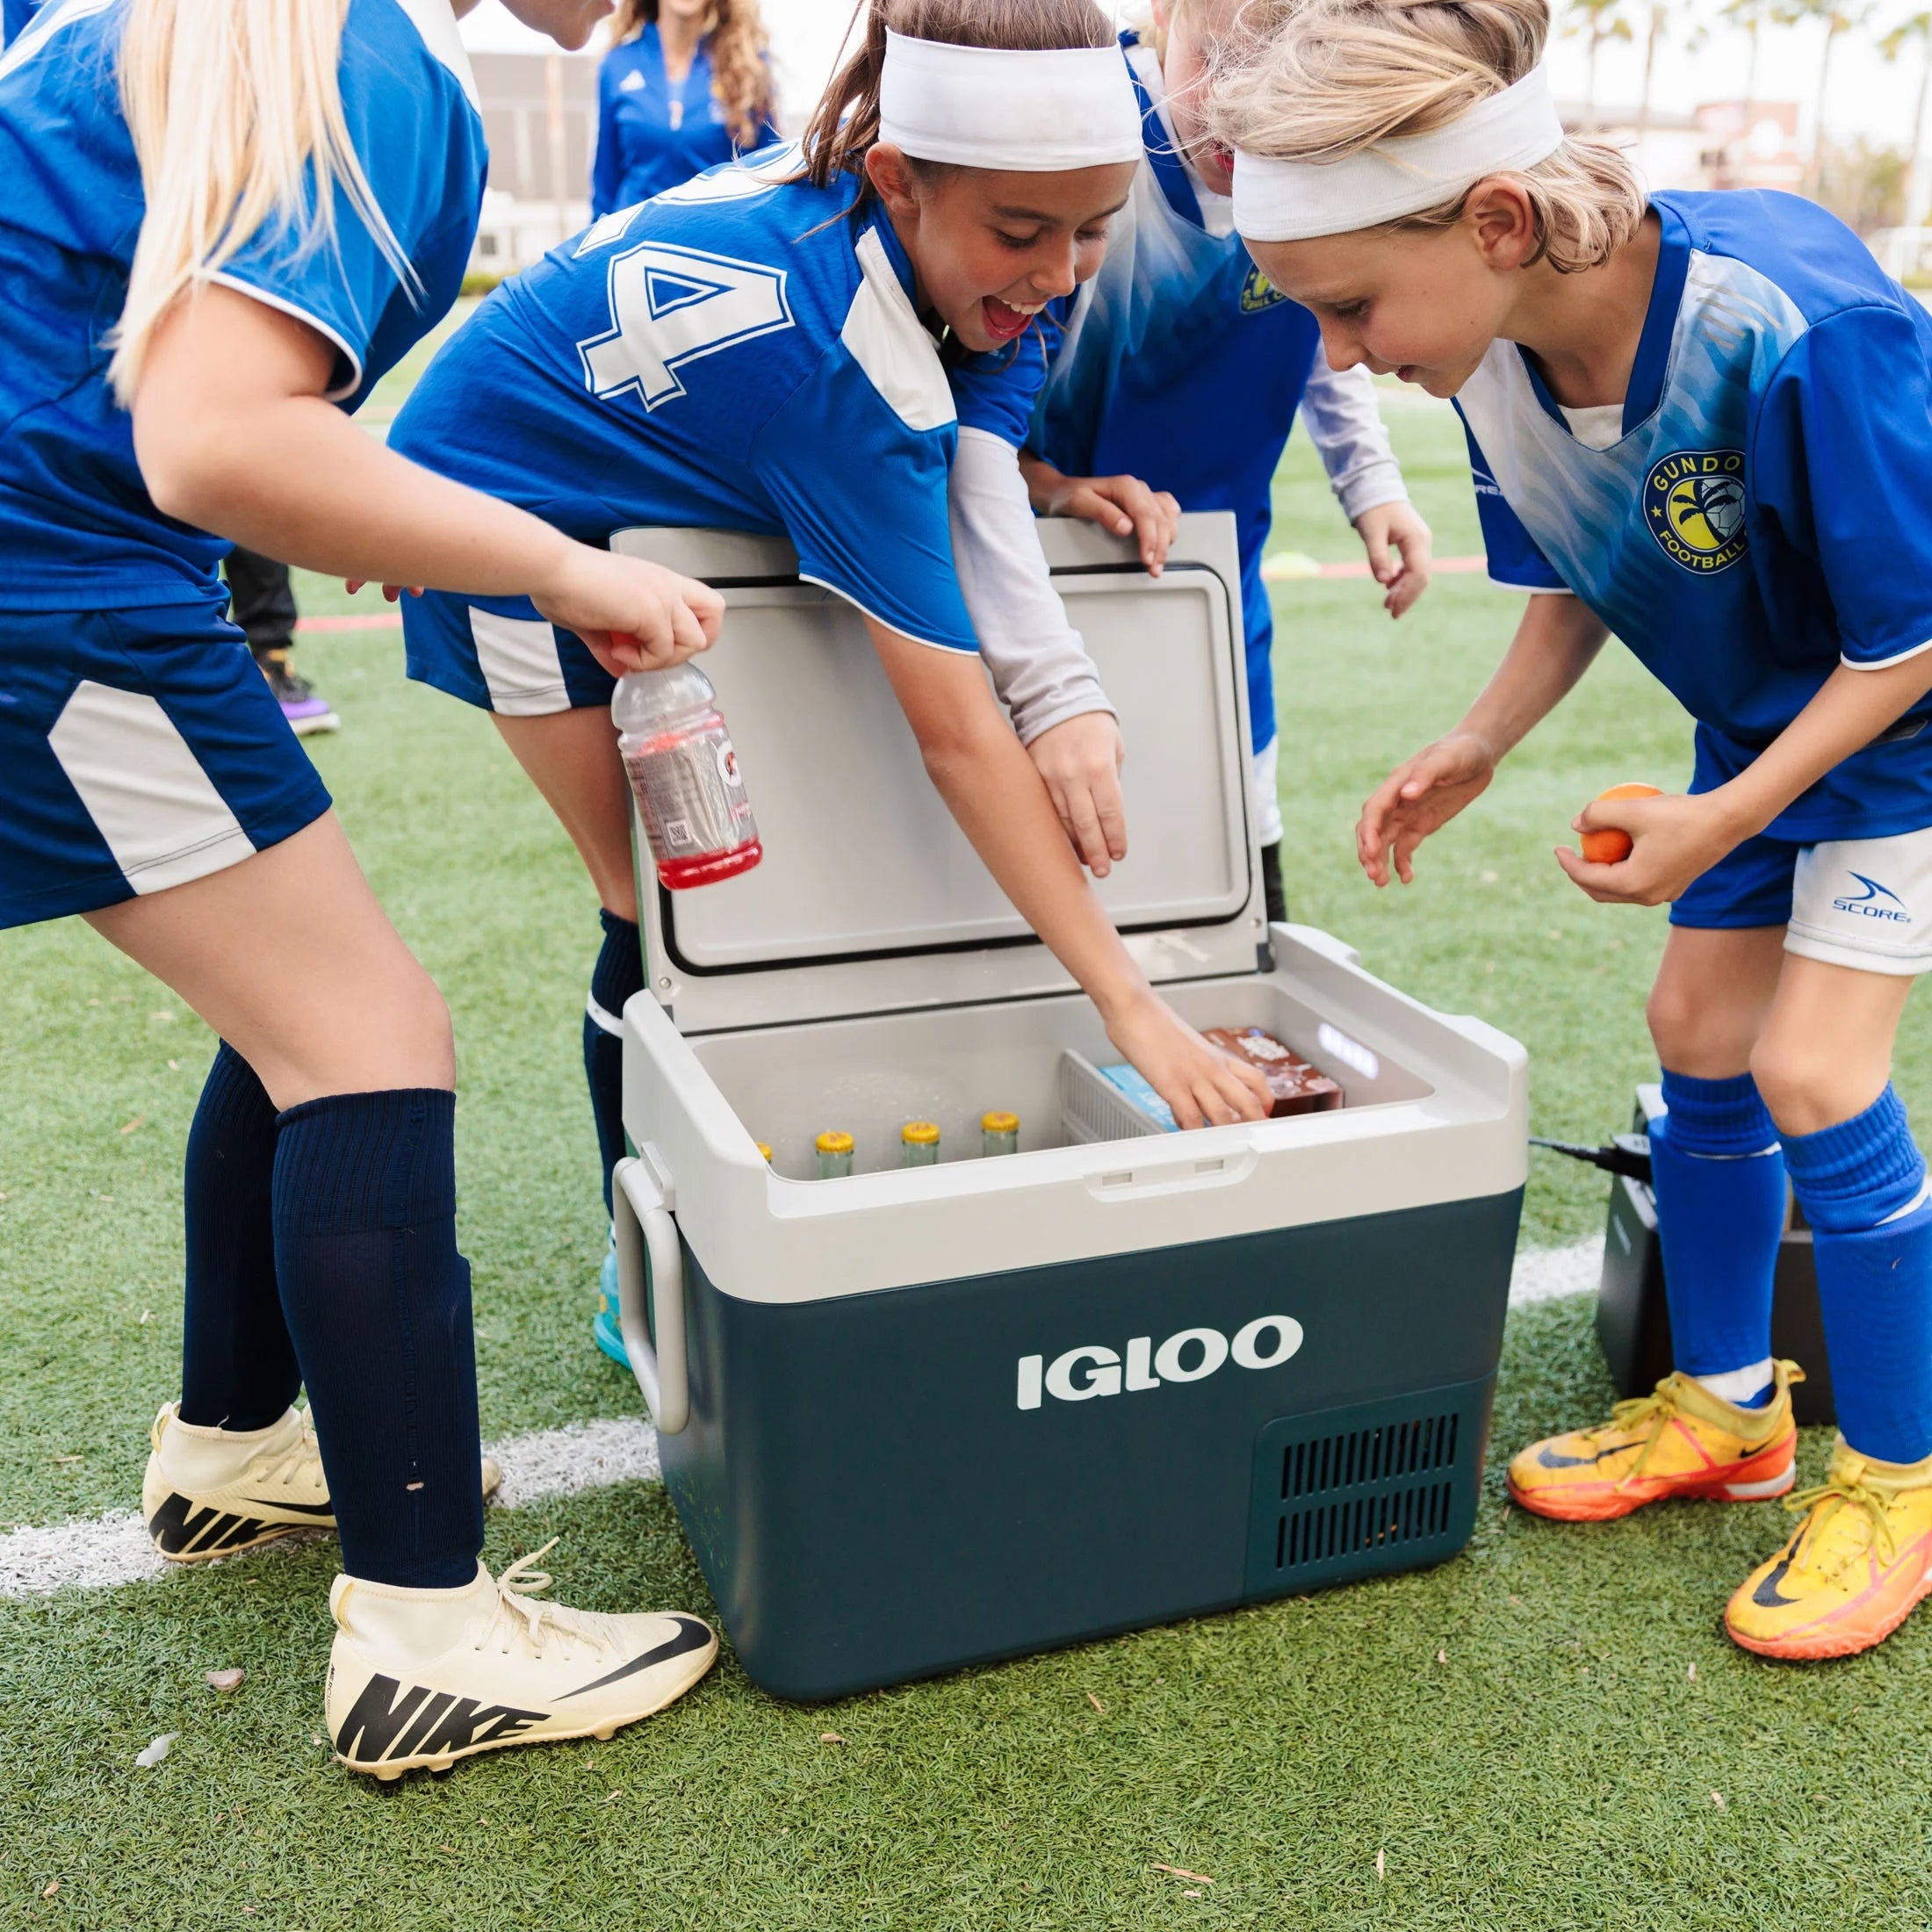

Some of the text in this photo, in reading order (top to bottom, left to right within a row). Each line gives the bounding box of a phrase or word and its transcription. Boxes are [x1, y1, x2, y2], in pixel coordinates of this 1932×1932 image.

[1654, 456, 1741, 491] GUNDO
[1660, 530, 1745, 569] FOOTBALL
[1832, 899, 1907, 922] SCORE
[1017, 1315, 1304, 1410] IGLOO
[336, 1673, 551, 1762] NIKE
